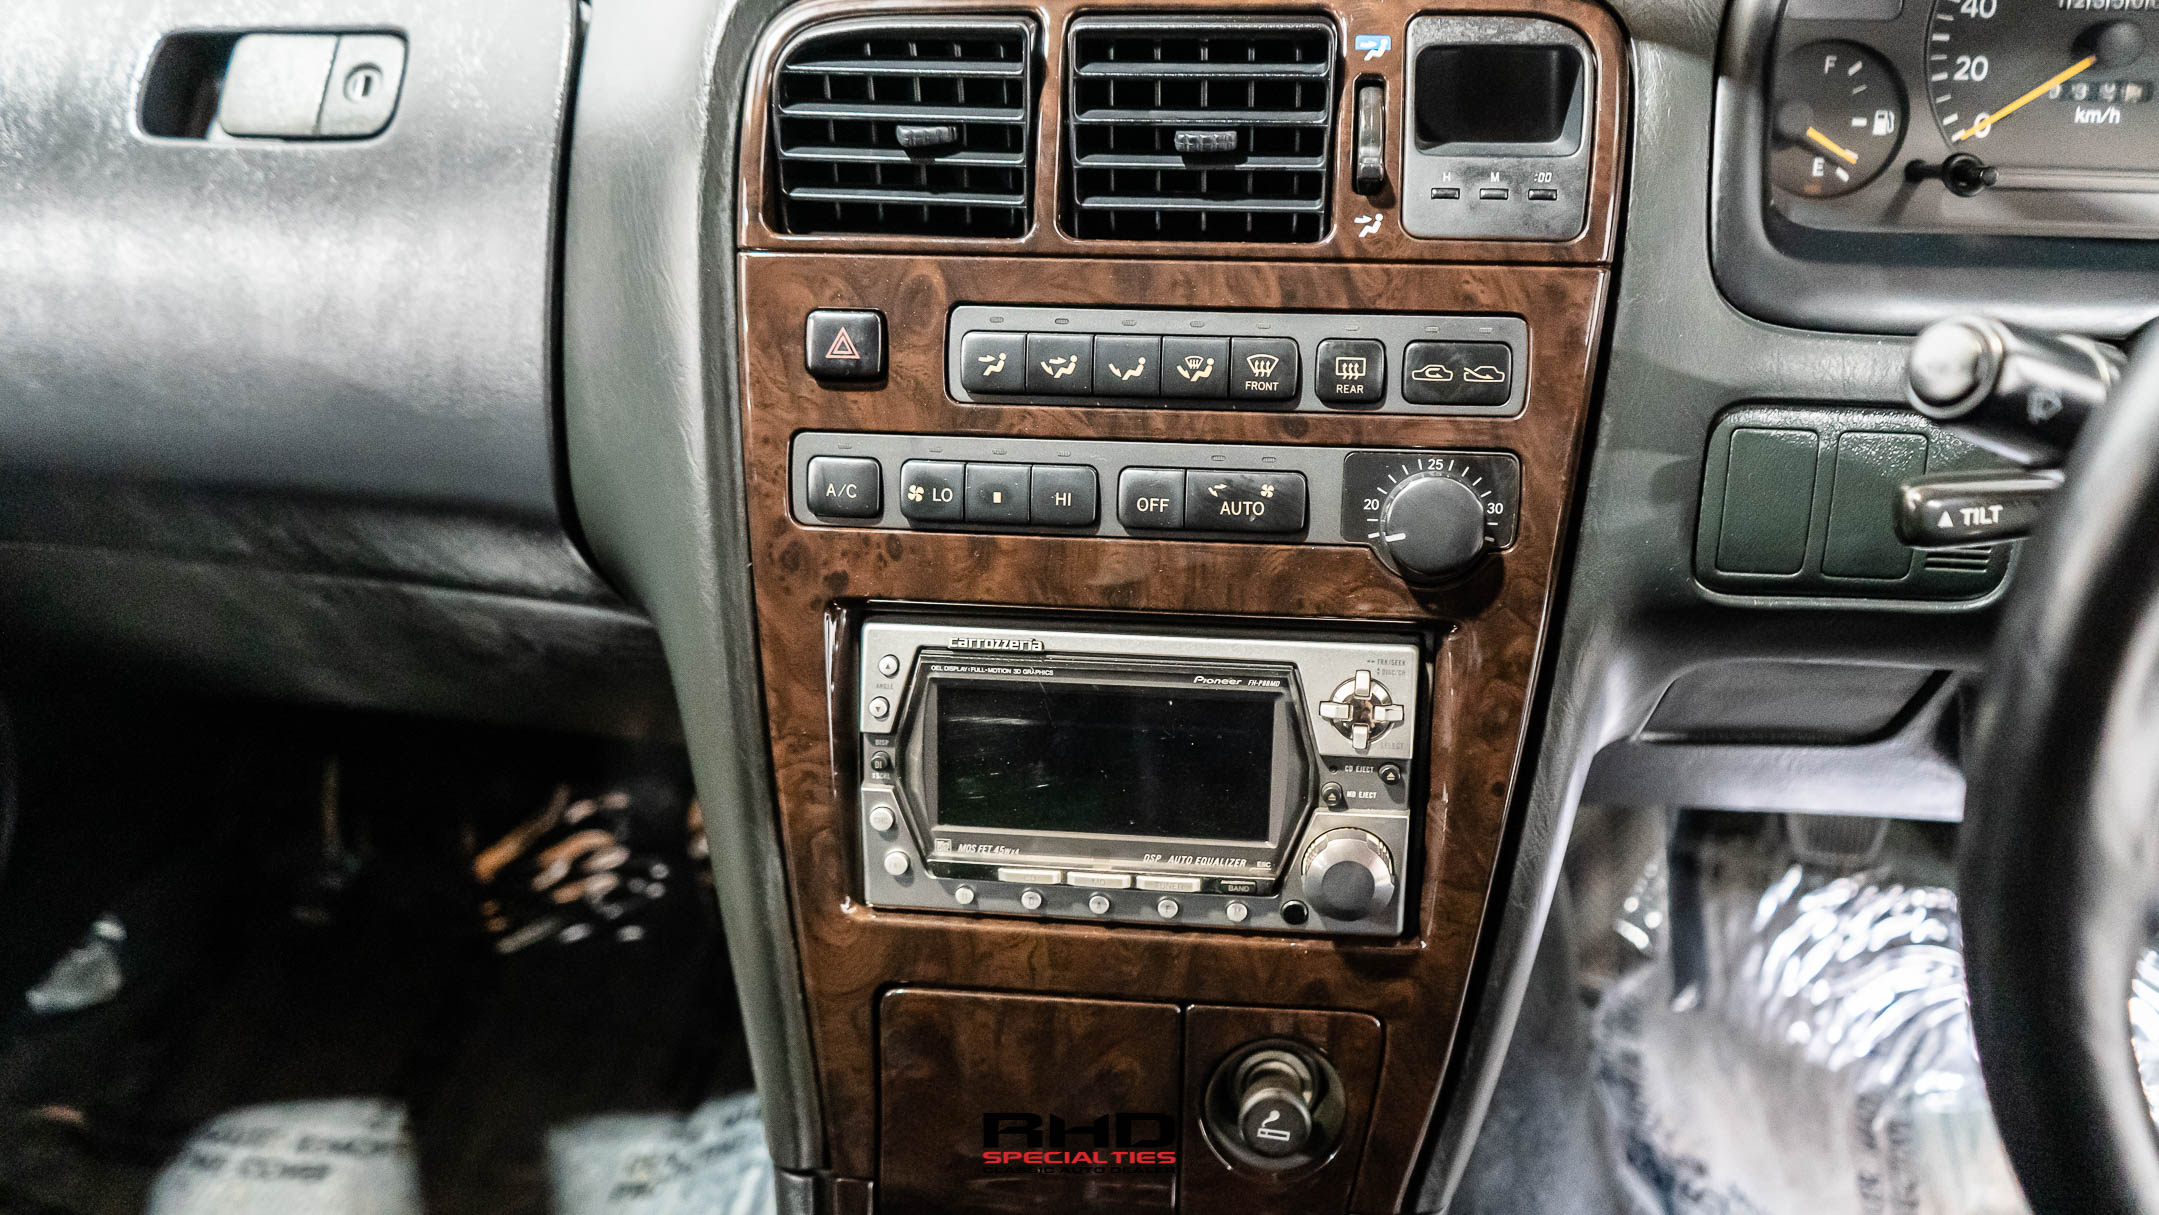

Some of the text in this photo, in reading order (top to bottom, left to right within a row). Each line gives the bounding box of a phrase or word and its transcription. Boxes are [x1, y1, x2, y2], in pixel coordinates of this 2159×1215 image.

[1961, 0, 1997, 18] 40
[1825, 55, 1837, 74] F
[1953, 55, 1989, 82] 20
[2074, 105, 2121, 124] km/h
[1812, 156, 1825, 177] E
[1442, 171, 1452, 182] H
[1490, 171, 1501, 183] M
[1533, 172, 1553, 183] :00
[1245, 381, 1279, 391] FRONT
[1336, 384, 1364, 394] REAR
[1427, 458, 1444, 471] 25
[826, 483, 857, 498] A/C
[932, 487, 953, 502] LO
[1055, 492, 1072, 507] HI
[1136, 497, 1170, 513] OFF
[1363, 498, 1380, 511] 20
[1220, 501, 1265, 516] AUTO
[1486, 502, 1504, 515] 30
[1959, 505, 2003, 526] TILT
[949, 636, 1044, 652] carrozzeria
[1193, 675, 1243, 685] Pioneer
[1355, 765, 1375, 774] EJECT
[1358, 791, 1378, 799] EJECT
[958, 843, 976, 853] MOS
[977, 844, 994, 855] FET
[1143, 853, 1248, 868] DSP AUTO EQUALIZER
[1228, 884, 1250, 893] BAND
